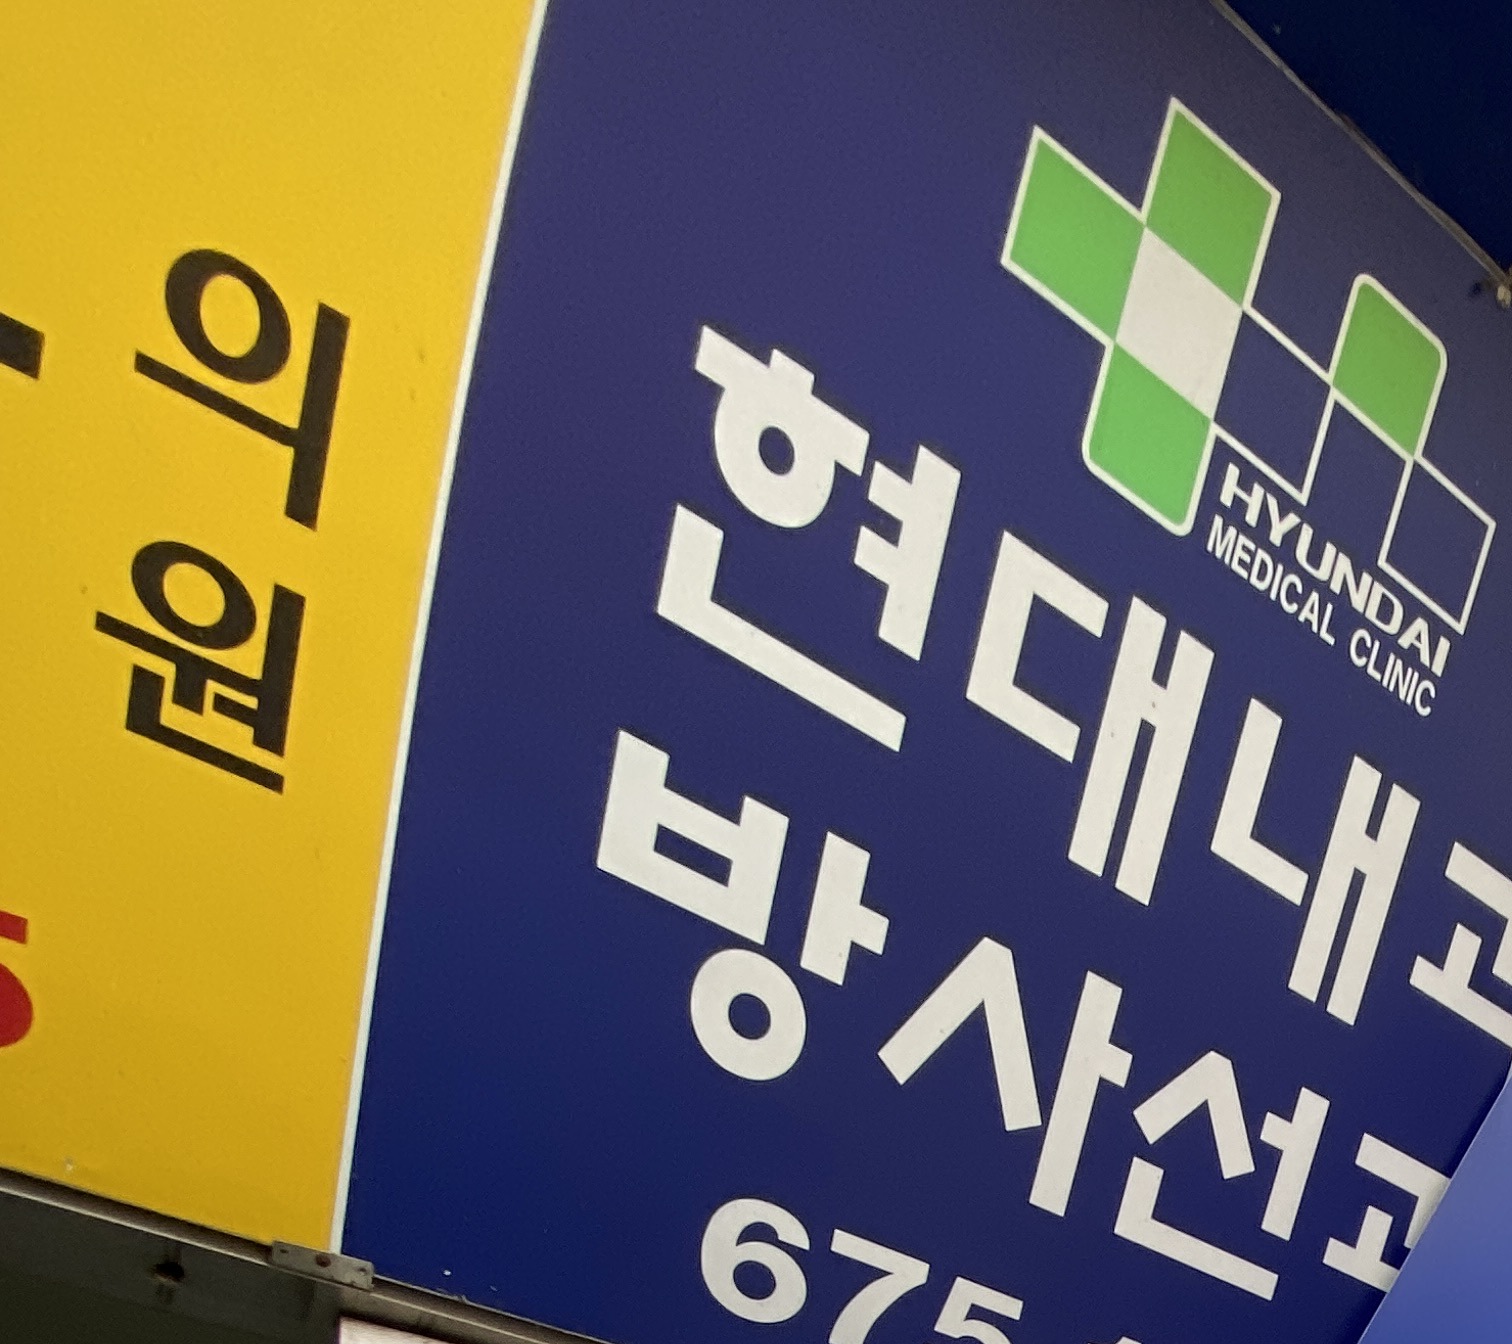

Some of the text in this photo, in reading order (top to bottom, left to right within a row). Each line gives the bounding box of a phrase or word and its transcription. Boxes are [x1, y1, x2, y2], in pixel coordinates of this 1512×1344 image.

[94, 247, 350, 796] 의원
[1206, 513, 1437, 719] MEDICAL CLINIC
[1217, 461, 1452, 677] HYUNDAI
